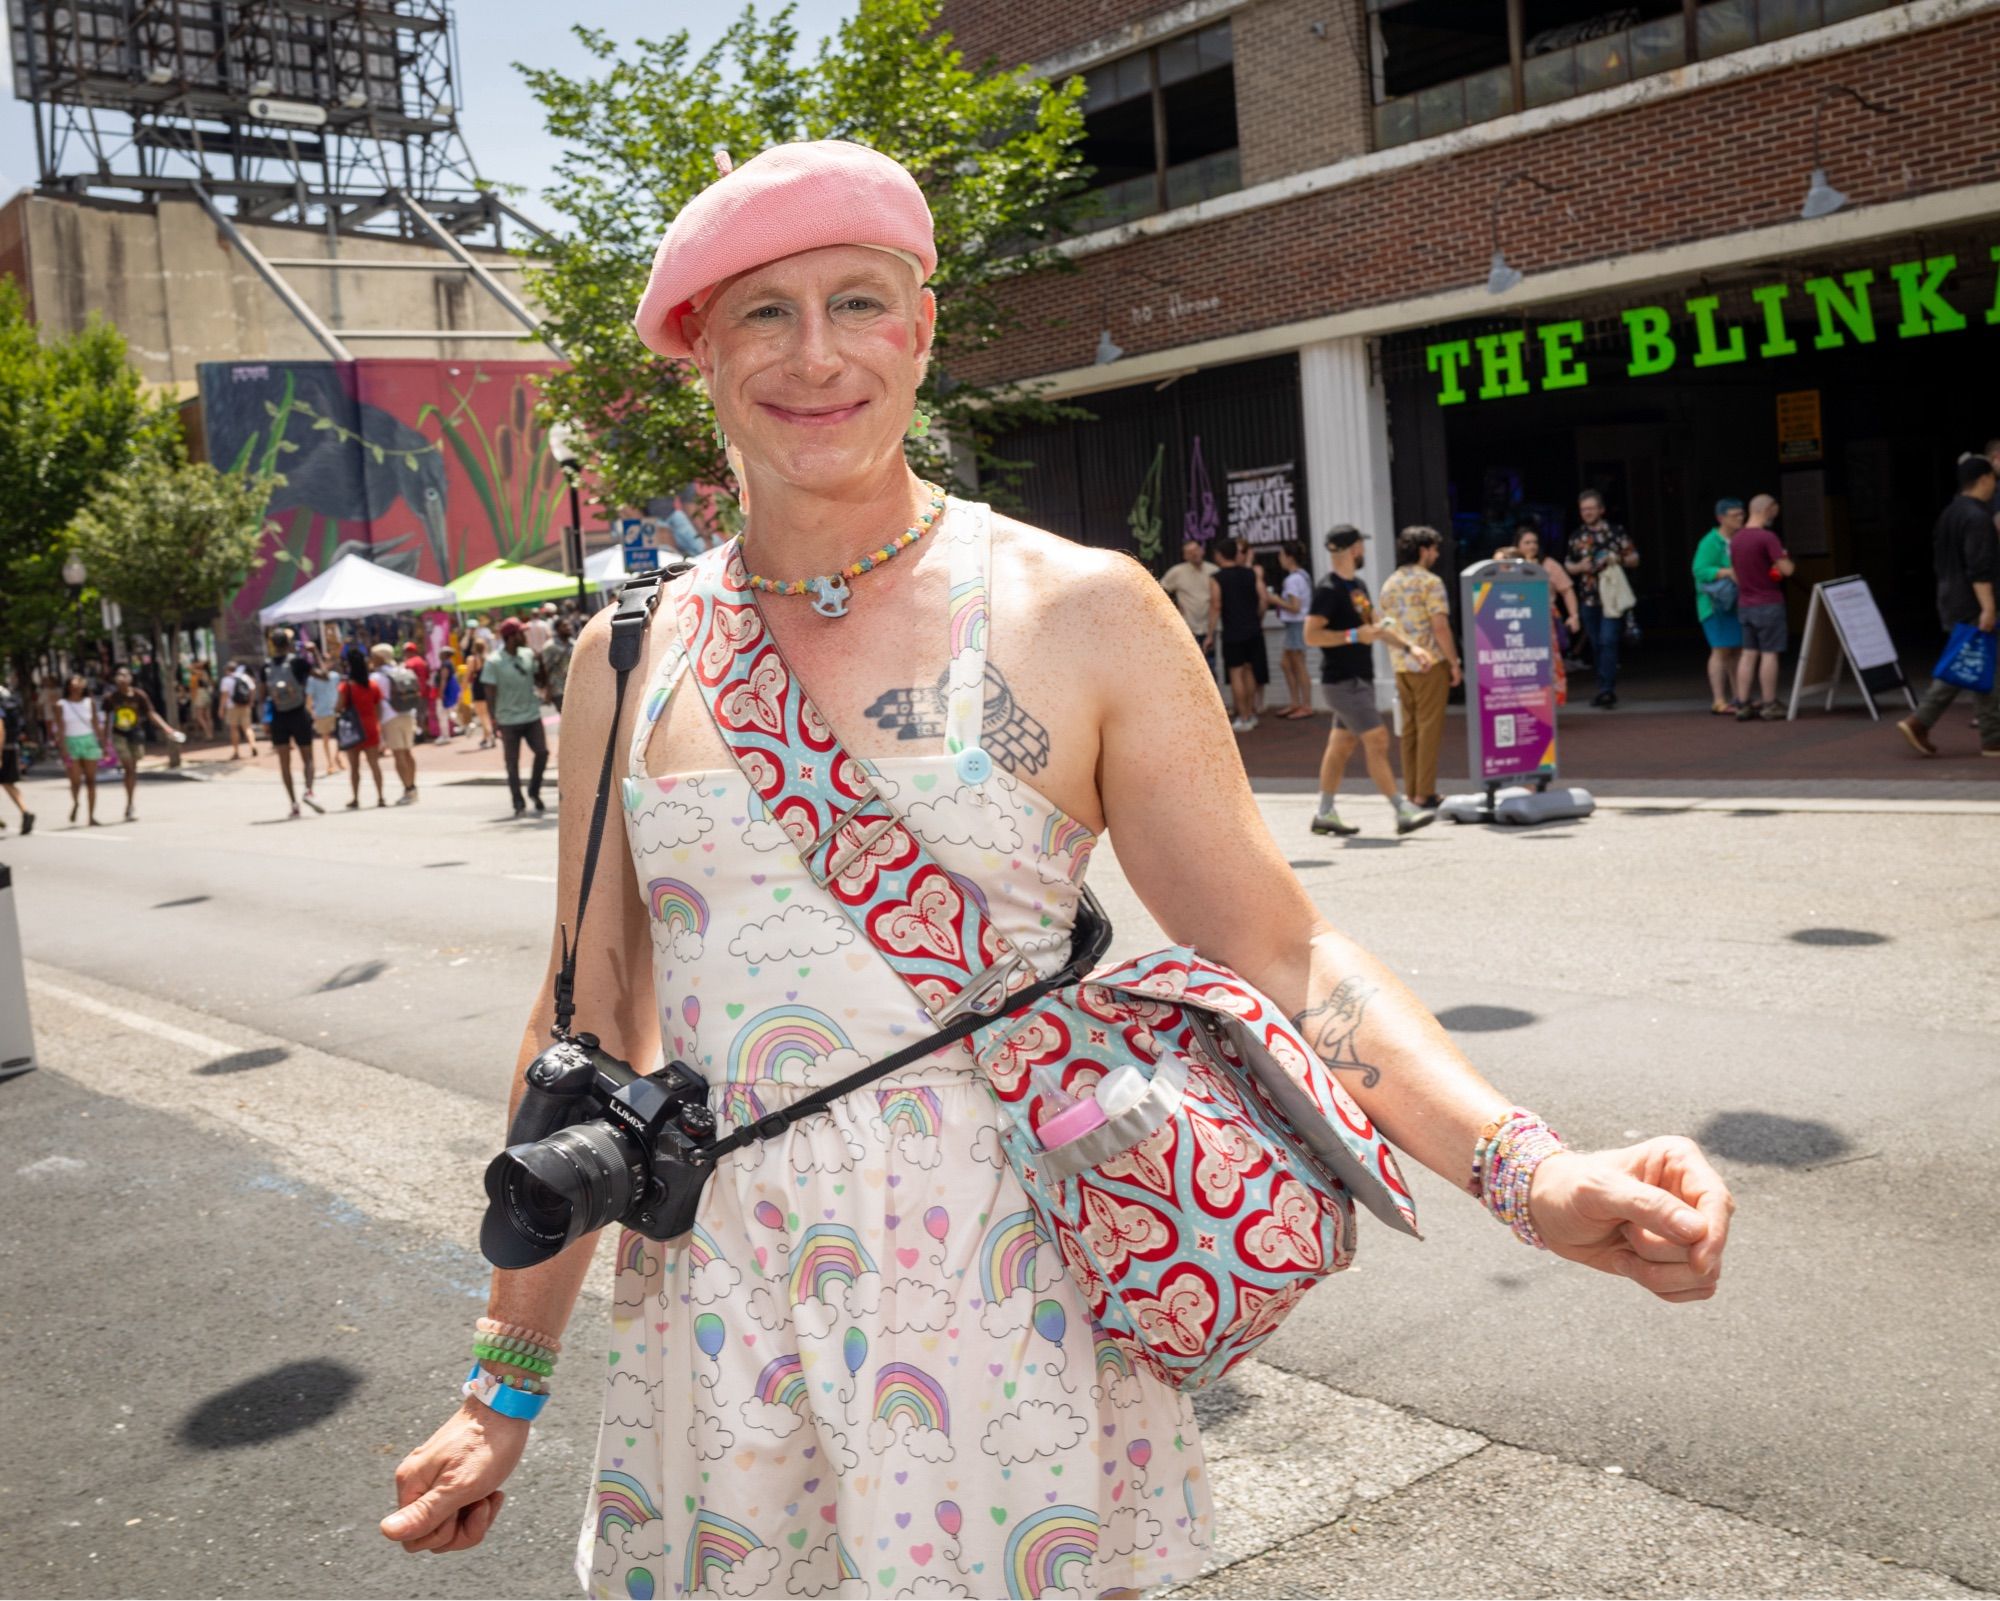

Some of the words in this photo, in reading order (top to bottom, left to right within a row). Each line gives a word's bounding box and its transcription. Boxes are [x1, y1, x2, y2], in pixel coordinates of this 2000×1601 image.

[1426, 320, 1588, 406] THE
[1621, 246, 2000, 378] BLINK
[1240, 488, 1295, 521] SKATE
[1504, 633, 1524, 648] THE
[1492, 662, 1538, 678] RETURNS
[609, 1099, 646, 1132] LUMIX
